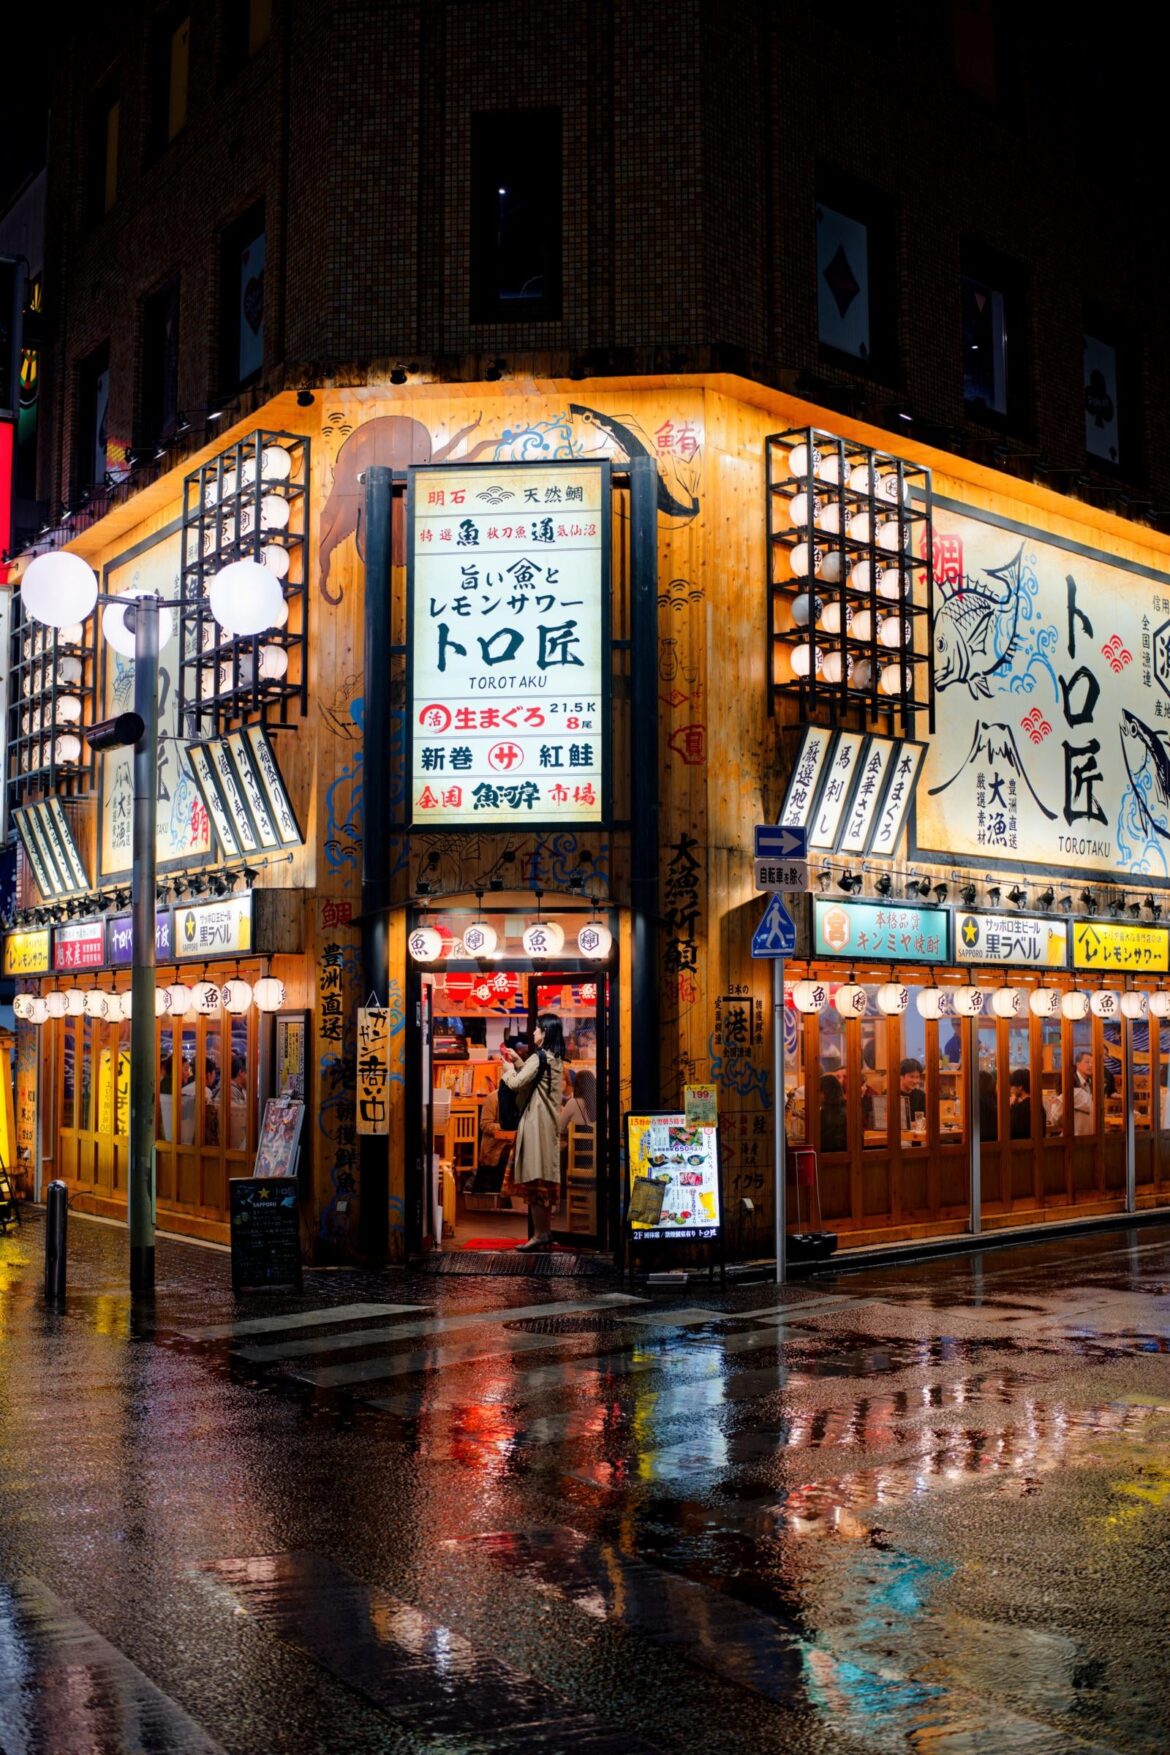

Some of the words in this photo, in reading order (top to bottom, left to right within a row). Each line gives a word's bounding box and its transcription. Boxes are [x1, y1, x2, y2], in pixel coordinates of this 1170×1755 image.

[655, 420, 697, 456] 鮪
[427, 488, 466, 506] 明石
[523, 485, 583, 504] 天然鯛
[456, 518, 480, 546] 魚
[486, 526, 527, 540] 秋刀魚
[531, 517, 555, 543] 通
[460, 558, 560, 591] 旨い魚と
[430, 593, 584, 618] レモンサワー
[437, 619, 585, 673] トロ匠
[469, 675, 547, 690] TOROTAKU
[1058, 574, 1109, 827] トロ匠
[454, 704, 545, 730] 生まぐろ
[421, 746, 474, 771] 新巻
[539, 743, 594, 768] 紅鮭
[237, 747, 271, 836] カマ焼き
[415, 785, 463, 810] 全国
[472, 780, 541, 811] 魚河岸
[547, 782, 597, 807] 市場
[819, 745, 852, 835] 馬刺し
[850, 751, 882, 838] 金華さば
[880, 755, 913, 842] 本まぐろ
[987, 772, 1007, 848] 大漁
[1058, 836, 1111, 858] TOROTAKU
[759, 867, 803, 885] 自転車を除く
[200, 924, 231, 946] 黒ラベル
[985, 919, 1041, 935] サッポロ生ビール
[411, 933, 428, 955] 魚
[528, 929, 547, 952] 魚
[856, 931, 940, 955] キンミヤ焼酎
[985, 934, 1041, 960] 黒ラベル
[958, 948, 983, 959] SAPPORO
[1103, 945, 1162, 964] レモンサワー
[202, 987, 218, 1008] 魚
[319, 942, 344, 1042] 豊洲直送
[728, 984, 749, 996] 日本の
[810, 986, 825, 1007] 魚
[969, 990, 982, 1011] 魚
[1098, 994, 1114, 1013] 魚
[732, 1173, 765, 1190] イクラ
